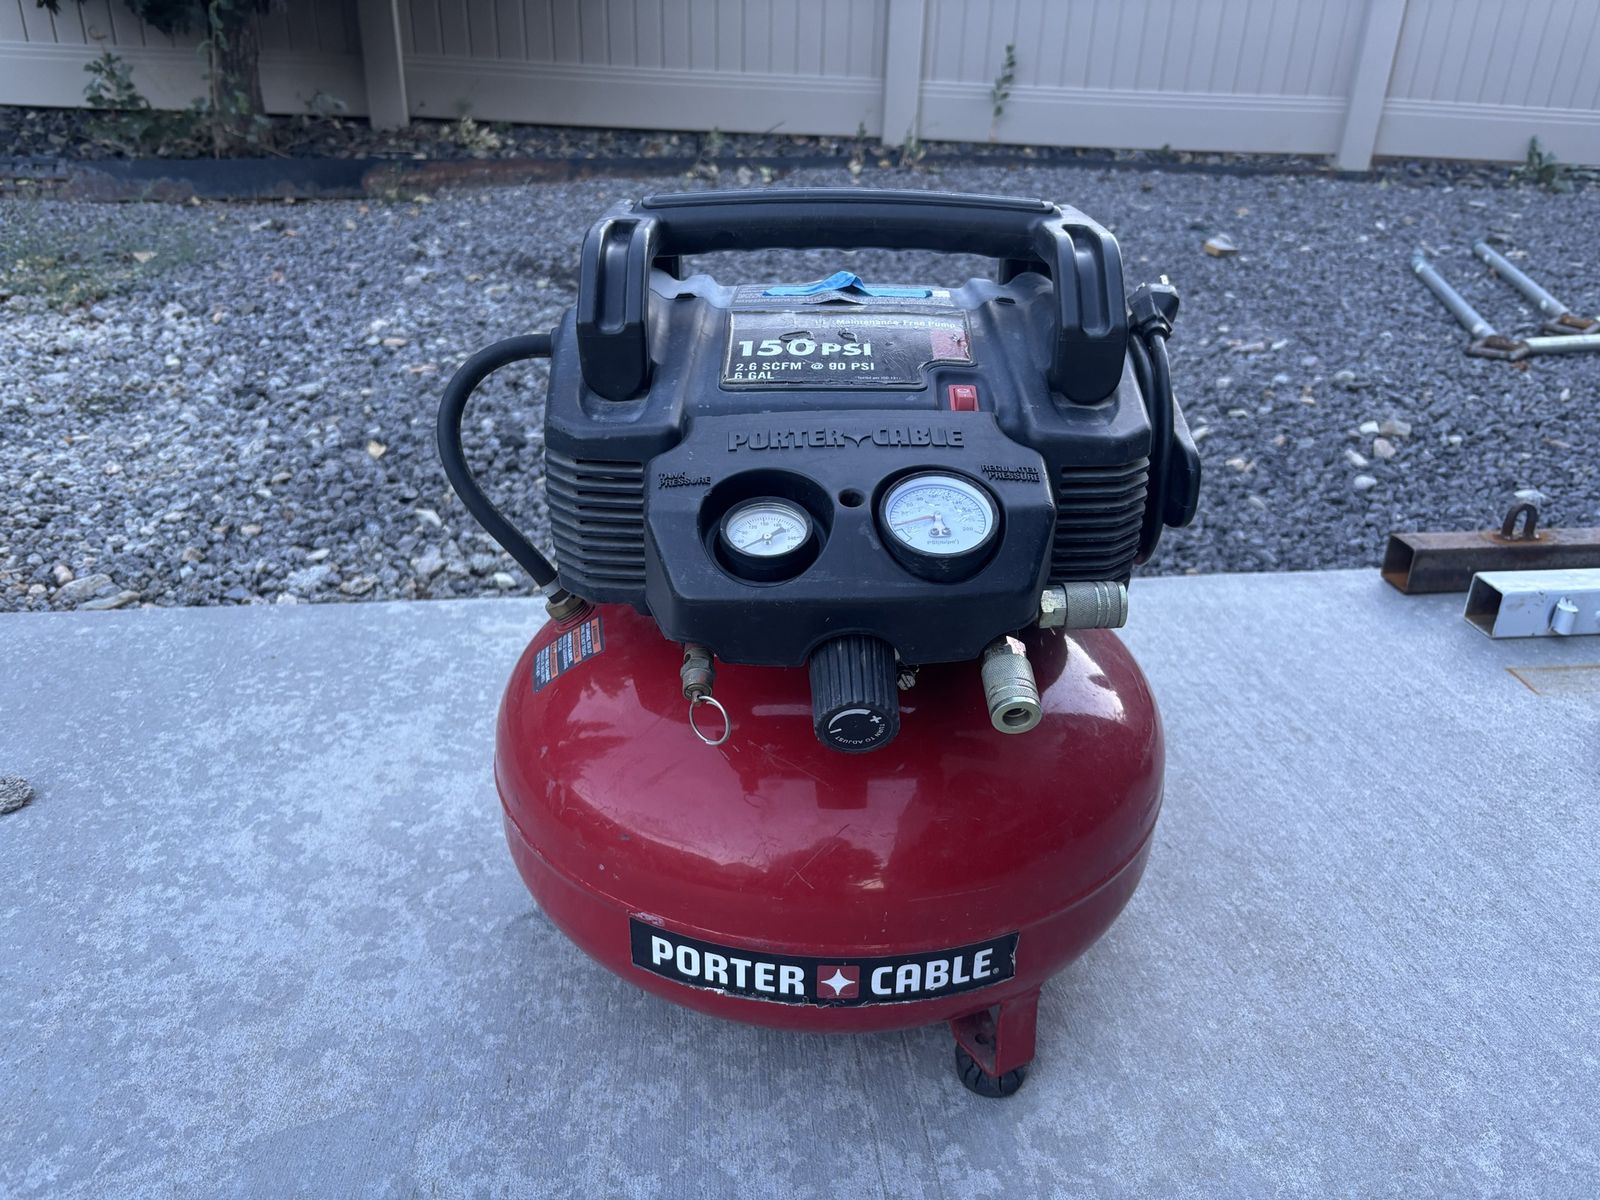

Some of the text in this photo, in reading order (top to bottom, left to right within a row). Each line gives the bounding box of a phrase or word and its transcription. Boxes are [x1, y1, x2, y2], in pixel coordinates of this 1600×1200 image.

[739, 338, 872, 356] 150 PSI
[735, 362, 758, 371] 2.6
[811, 362, 824, 370] @
[829, 362, 846, 371] 90
[851, 362, 875, 371] PSI
[735, 371, 775, 380] 6 GAL
[728, 425, 965, 452] PORTER CABLE
[980, 463, 1039, 474] REGULATED
[657, 476, 711, 489] PRESSURE
[988, 471, 1041, 483] PRESSURE
[835, 735, 863, 745] ADJUST
[651, 935, 806, 996] PORTER
